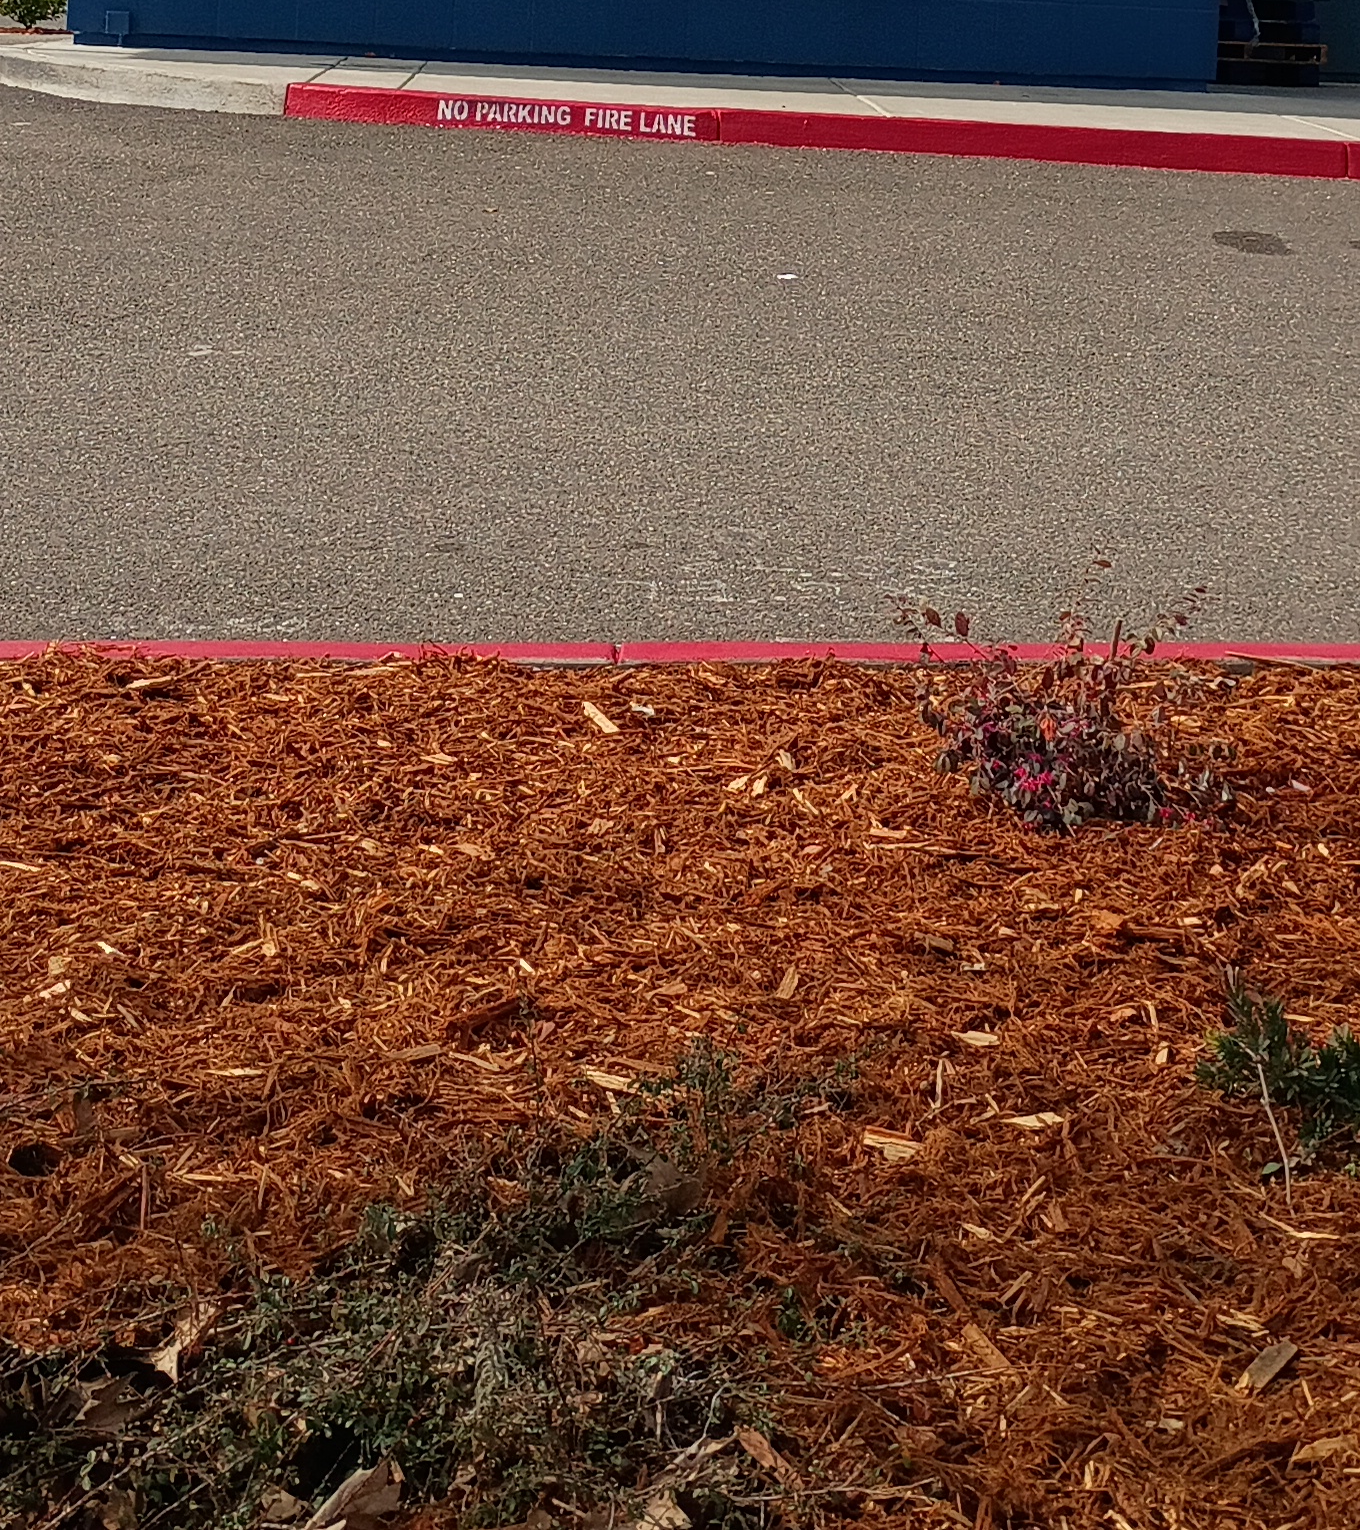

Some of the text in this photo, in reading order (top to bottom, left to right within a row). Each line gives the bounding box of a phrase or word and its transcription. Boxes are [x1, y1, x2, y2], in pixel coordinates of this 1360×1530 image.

[437, 99, 696, 137] NO PARKING FIRE LANE
